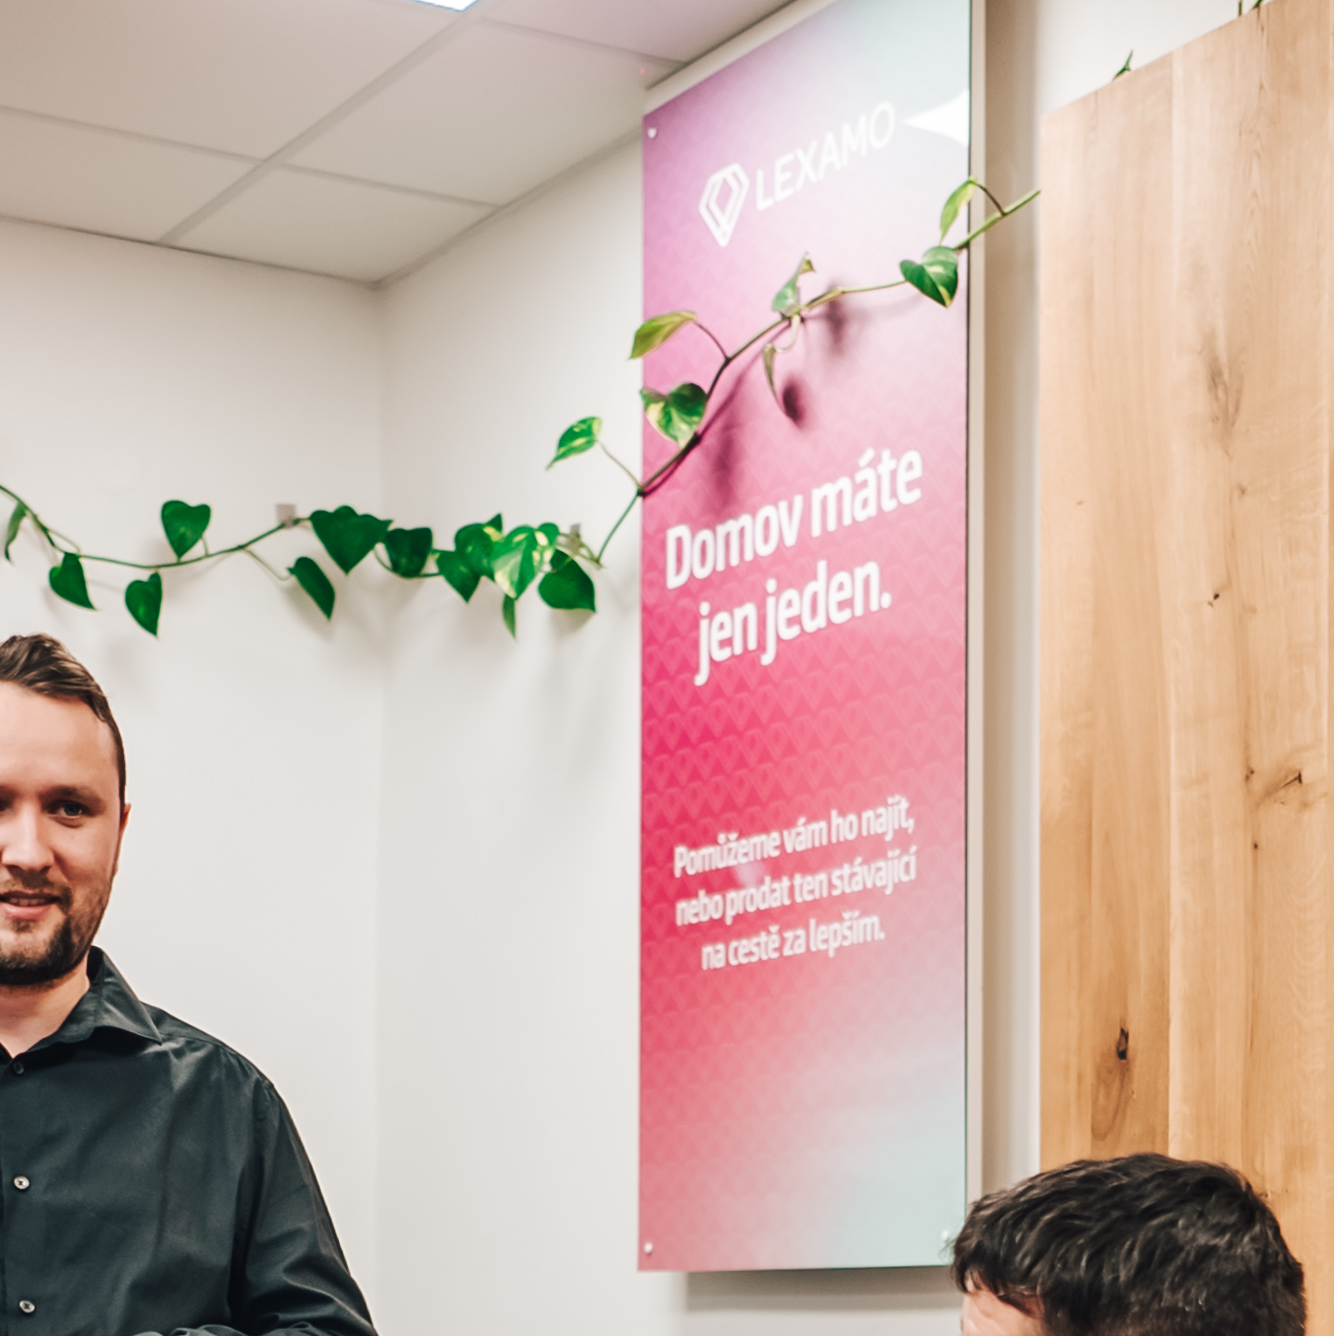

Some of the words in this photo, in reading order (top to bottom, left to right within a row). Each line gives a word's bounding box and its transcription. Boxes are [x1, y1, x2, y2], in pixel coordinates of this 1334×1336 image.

[756, 101, 896, 211] LEXAMO
[665, 494, 804, 589] Domov
[811, 448, 923, 538] máte
[694, 602, 758, 686] jen
[760, 560, 892, 665] jeden.
[673, 832, 781, 878] Pomůžeme
[783, 817, 828, 854] vám
[830, 809, 858, 843] ho
[862, 795, 915, 841] najít,
[675, 889, 723, 926] nebo
[725, 876, 791, 926] prodat
[794, 872, 828, 904] ten
[831, 846, 917, 896] stávající
[701, 942, 726, 971] na
[728, 924, 781, 966] cestě
[782, 929, 807, 956] za
[809, 910, 886, 957] lepším.
